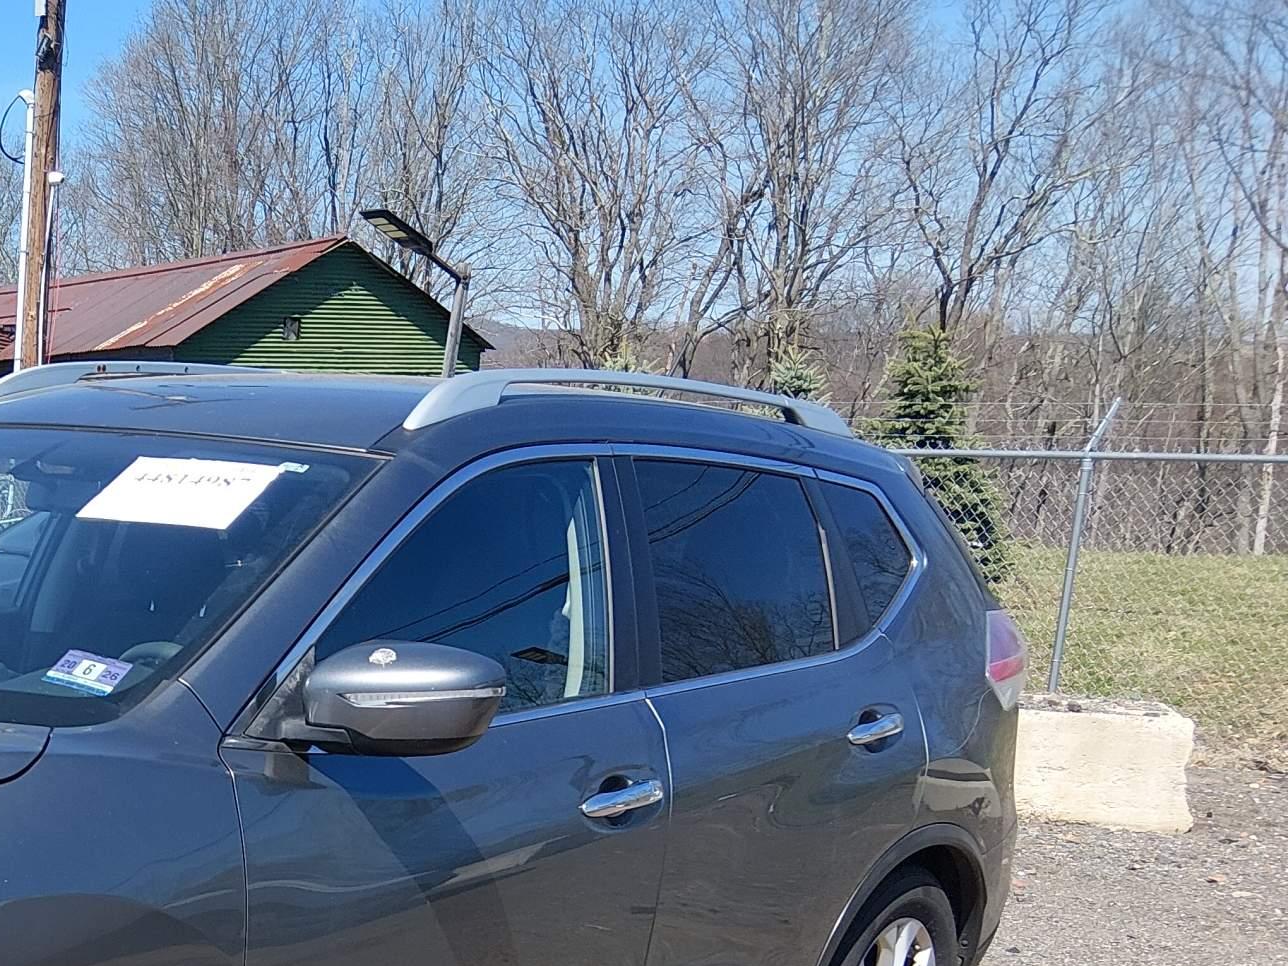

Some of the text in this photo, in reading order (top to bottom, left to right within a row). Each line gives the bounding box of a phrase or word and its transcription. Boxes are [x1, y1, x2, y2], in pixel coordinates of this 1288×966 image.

[60, 658, 78, 670] 20
[82, 663, 96, 676] 6
[101, 670, 120, 681] 26
